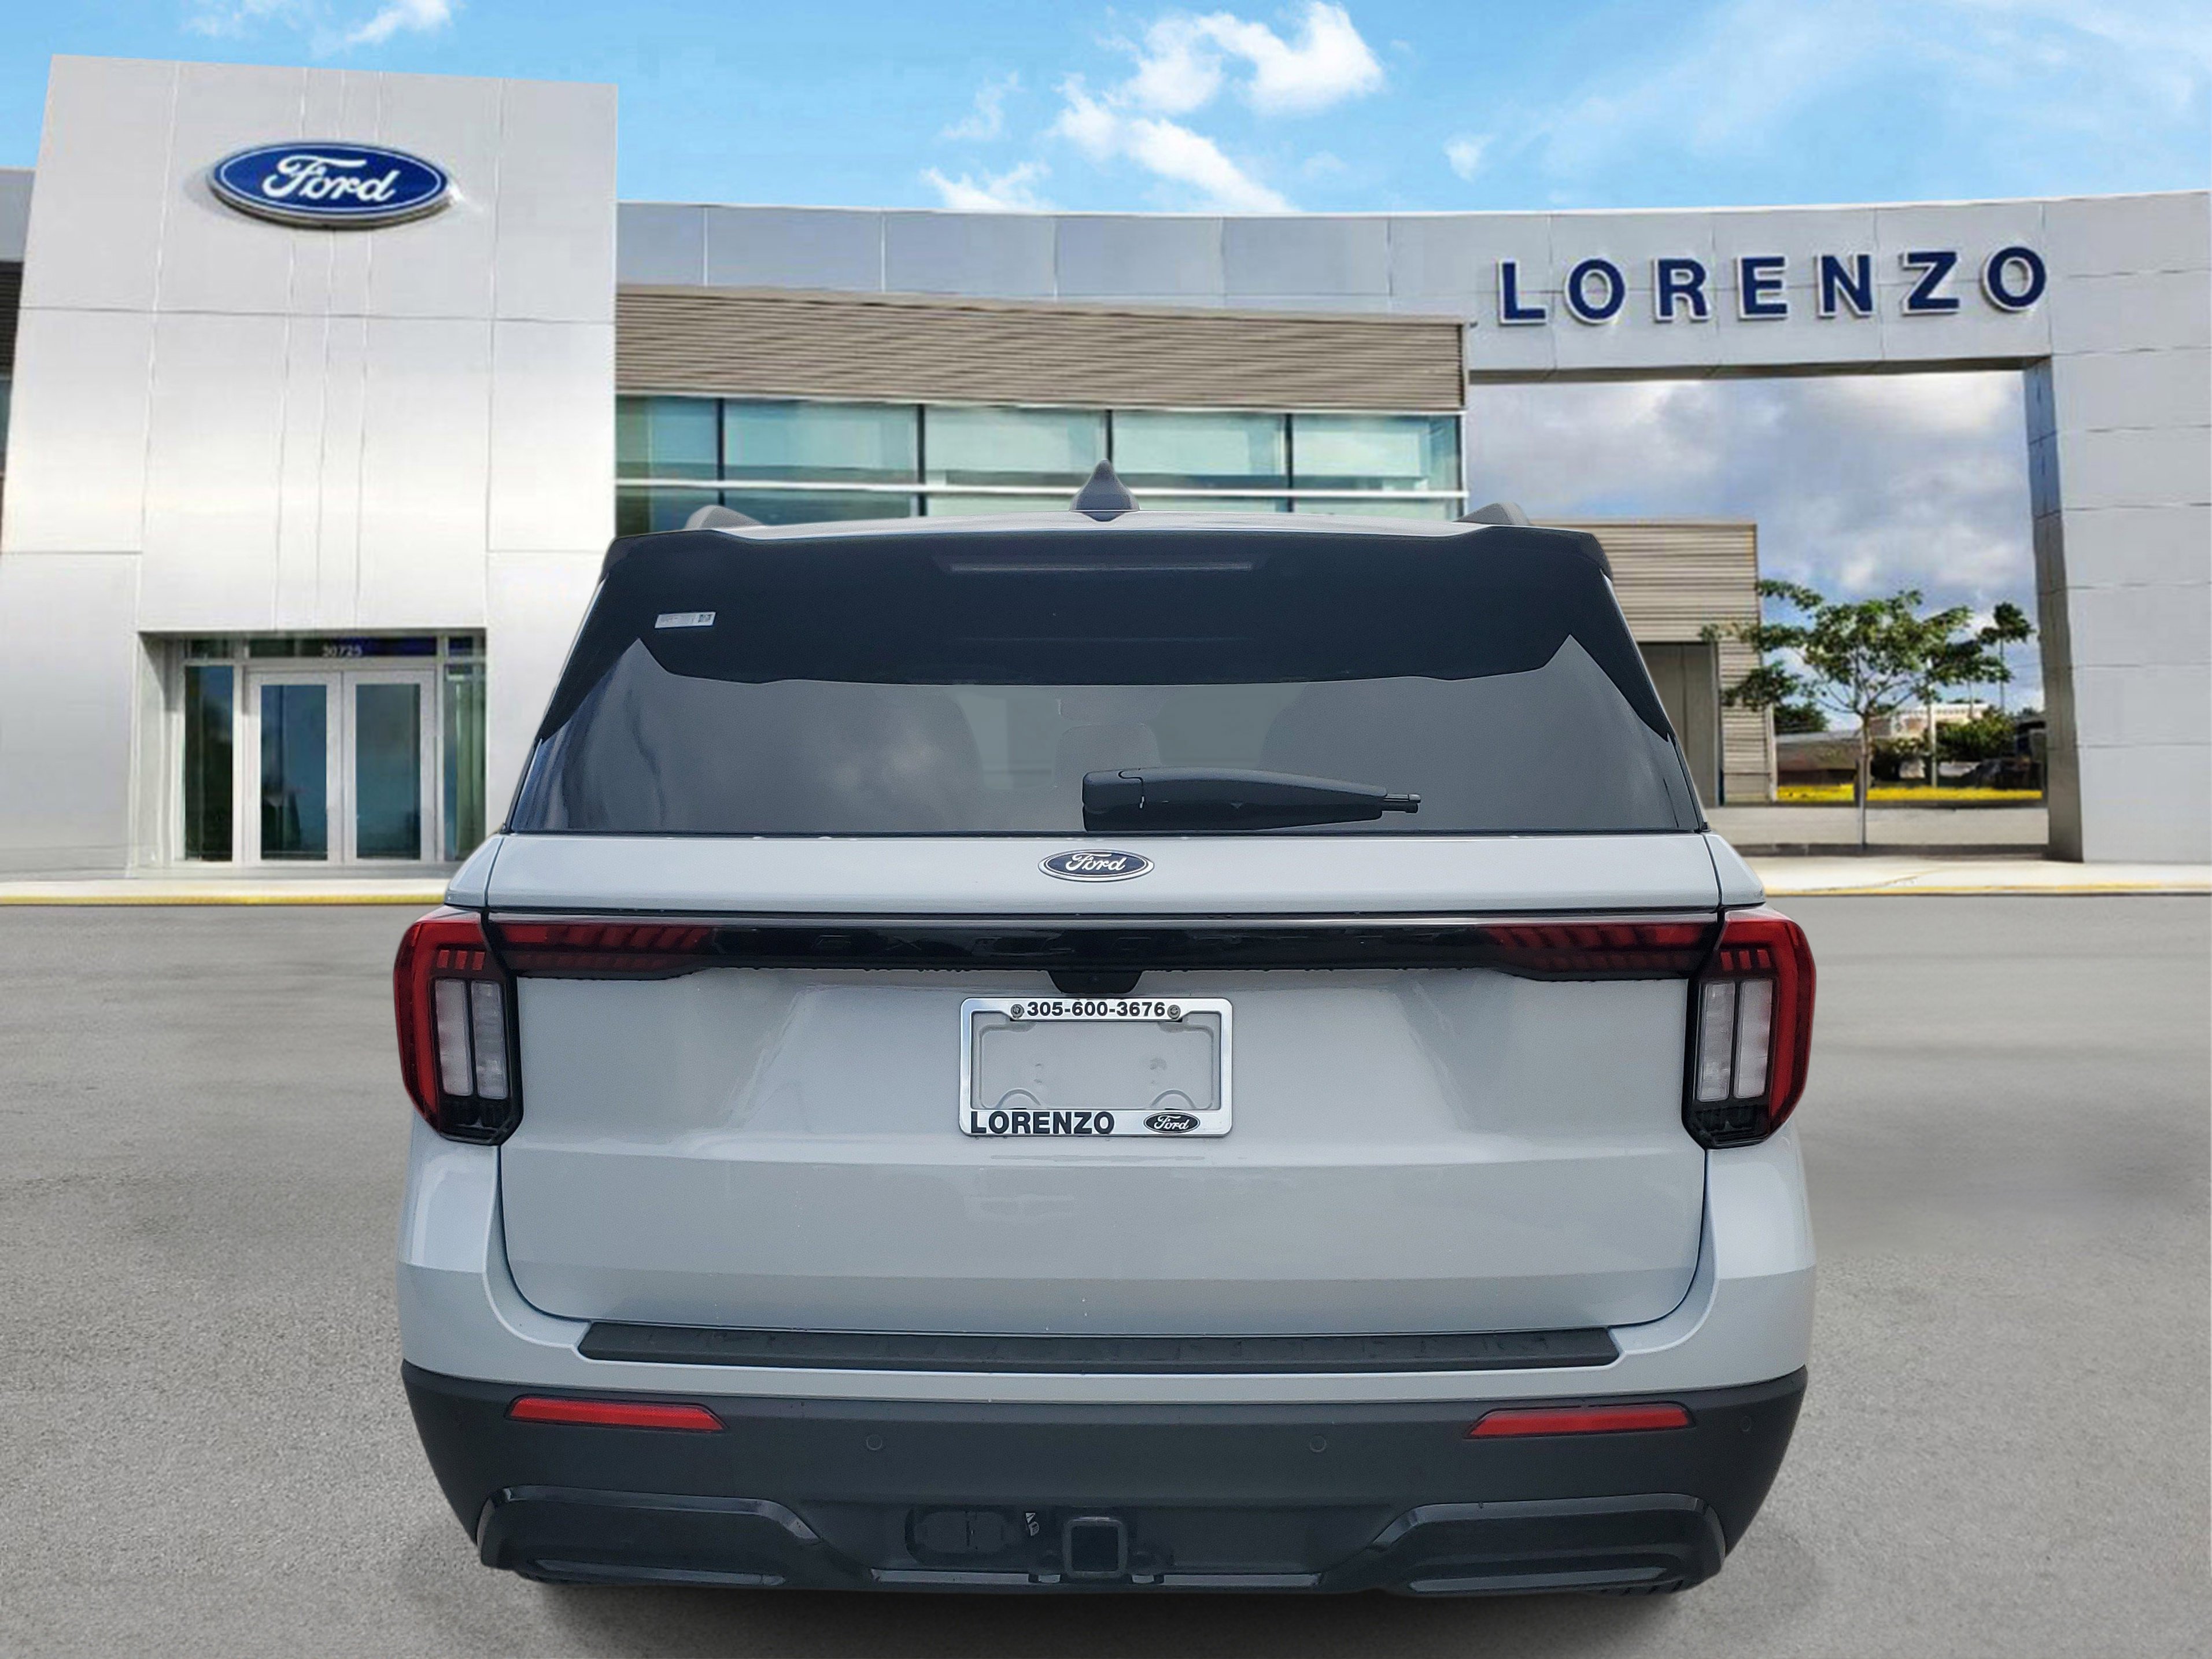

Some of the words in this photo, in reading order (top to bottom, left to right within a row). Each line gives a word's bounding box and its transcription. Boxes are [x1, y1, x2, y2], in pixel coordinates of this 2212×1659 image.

[262, 154, 400, 201] Ford
[1498, 246, 2048, 324] LORENZO
[1065, 853, 1127, 871] Ford
[1027, 1001, 1166, 1017] 305-600-3676
[970, 1111, 1115, 1135] LORENZO
[1153, 1115, 1190, 1130] Ford
